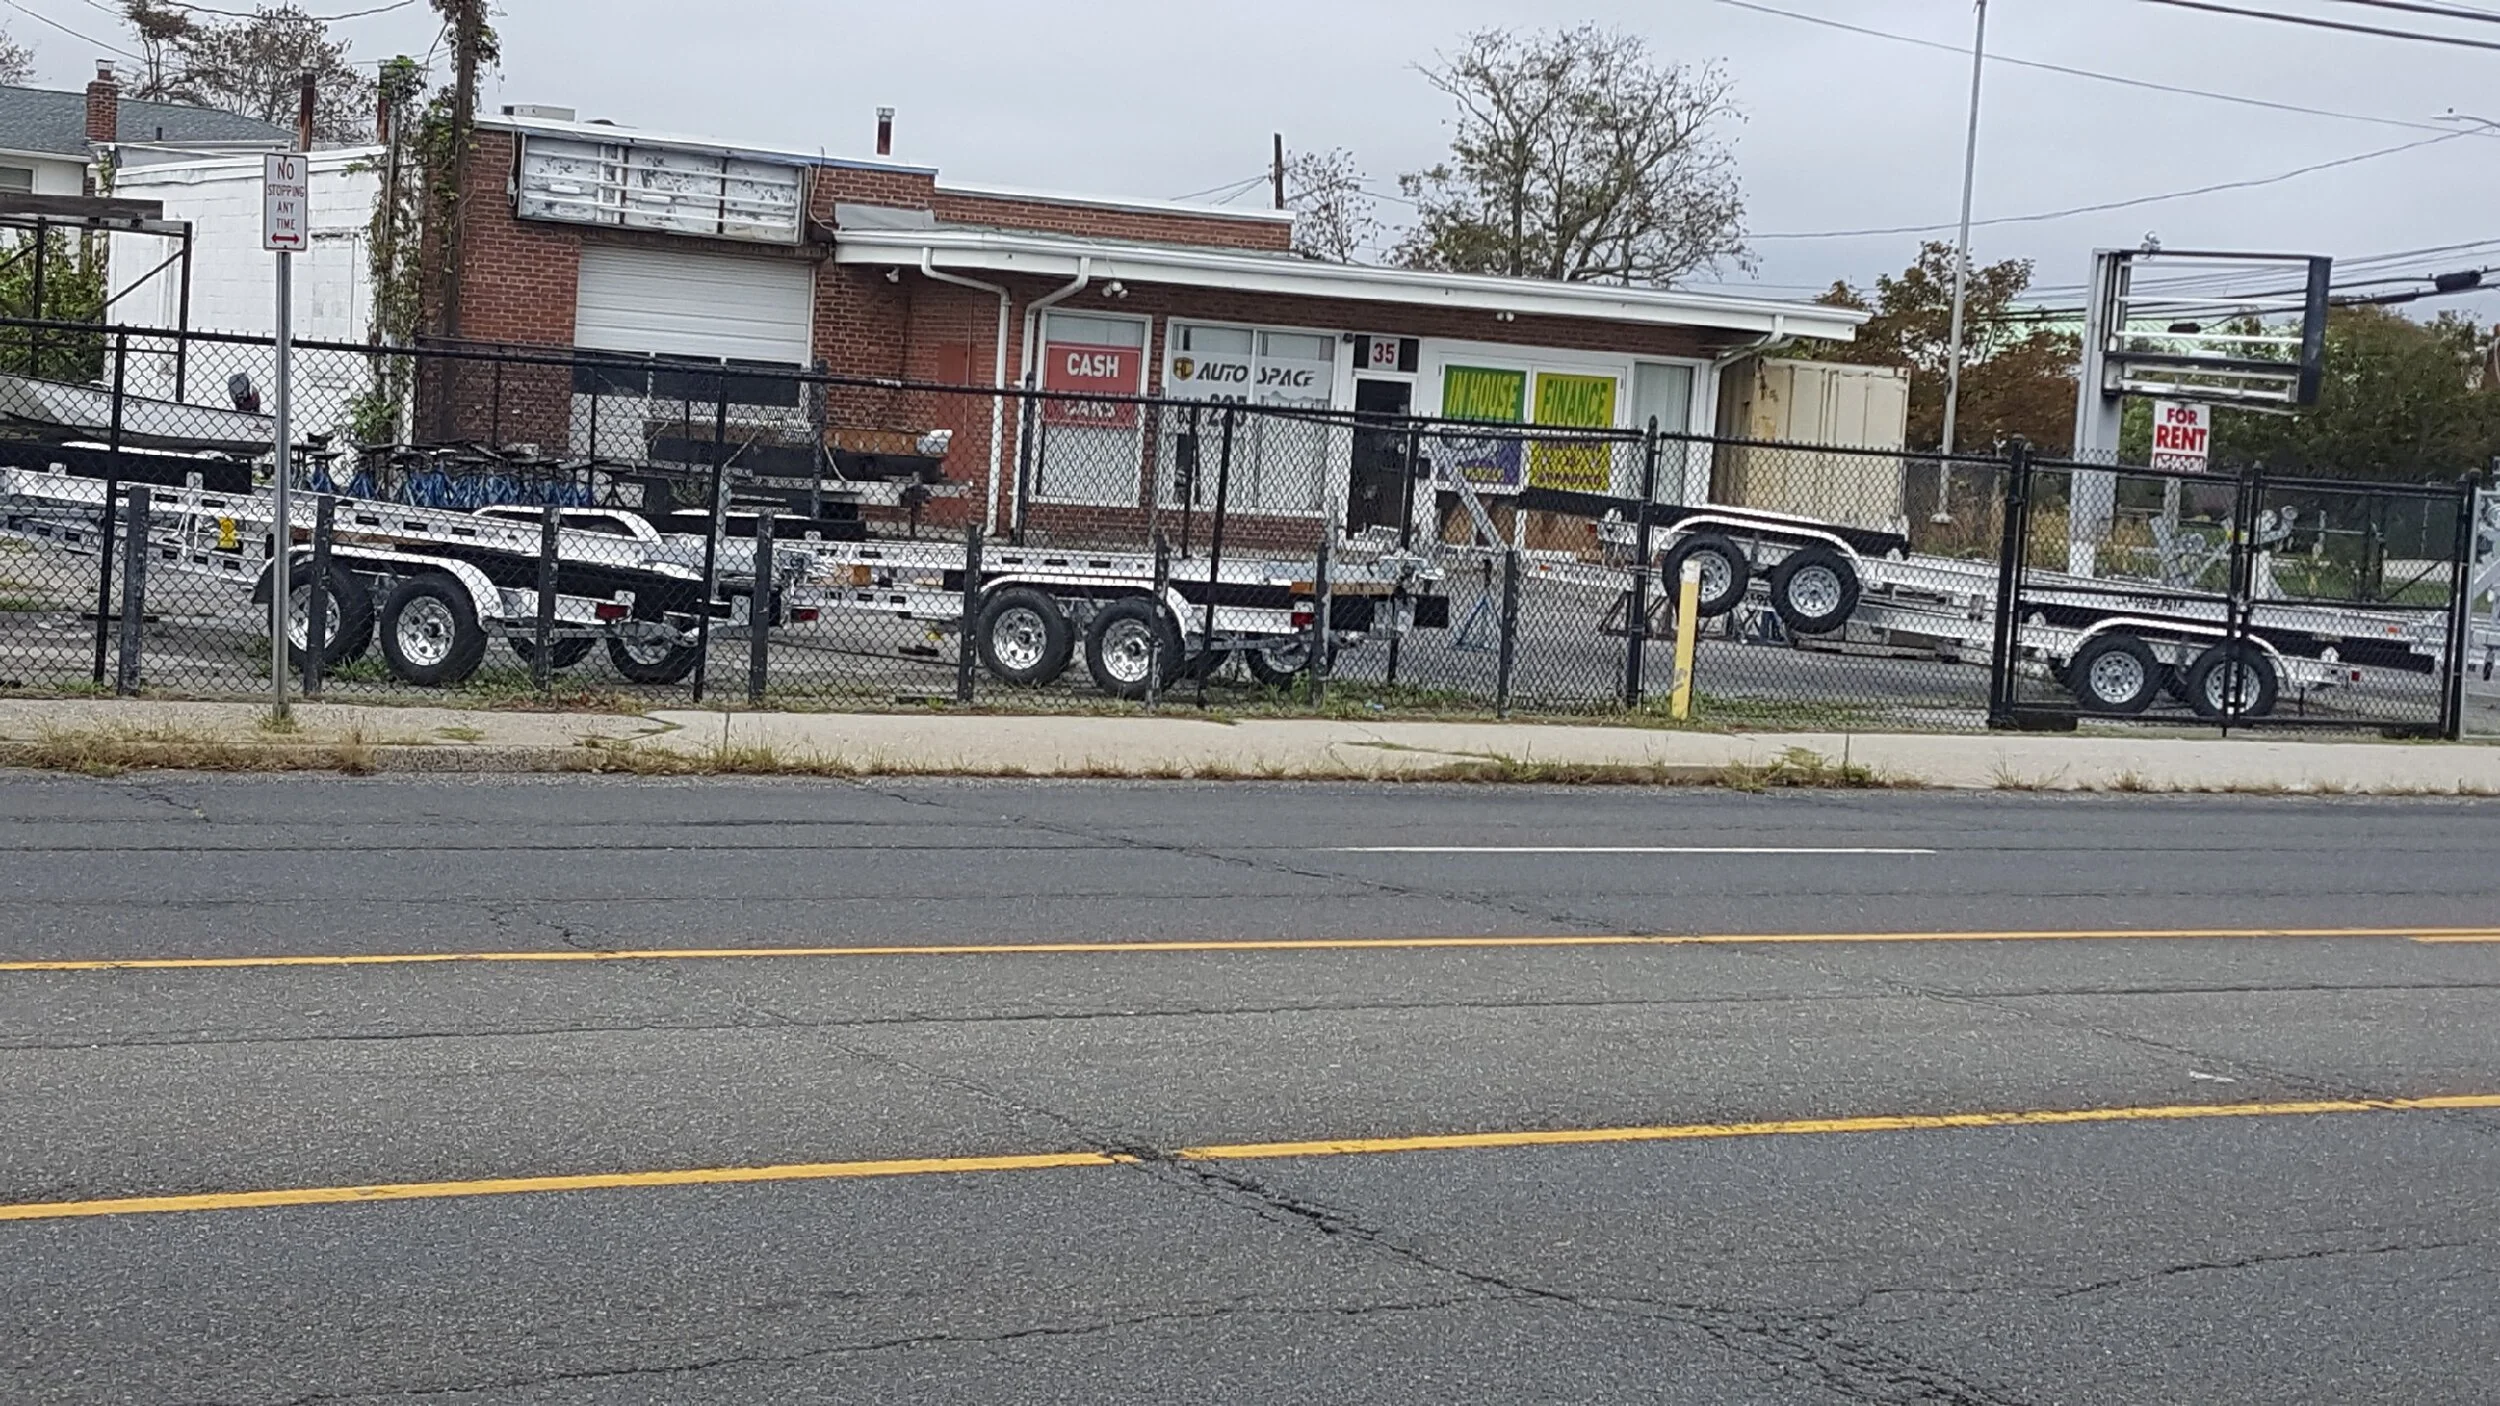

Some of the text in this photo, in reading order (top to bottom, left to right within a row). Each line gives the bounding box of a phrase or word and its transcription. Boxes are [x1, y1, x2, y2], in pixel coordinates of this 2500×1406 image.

[277, 162, 295, 180] NO
[267, 184, 305, 197] STOPPING
[276, 201, 295, 214] ANY
[276, 218, 296, 230] TIME
[1067, 352, 1120, 378] CASH
[1373, 342, 1395, 365] 35
[1196, 362, 1316, 388] AUTO SPACE
[1448, 371, 1521, 421] IN HOUSE
[1540, 377, 1609, 428] FINANCE
[2166, 407, 2198, 425] FOR
[2156, 424, 2208, 452] RENT
